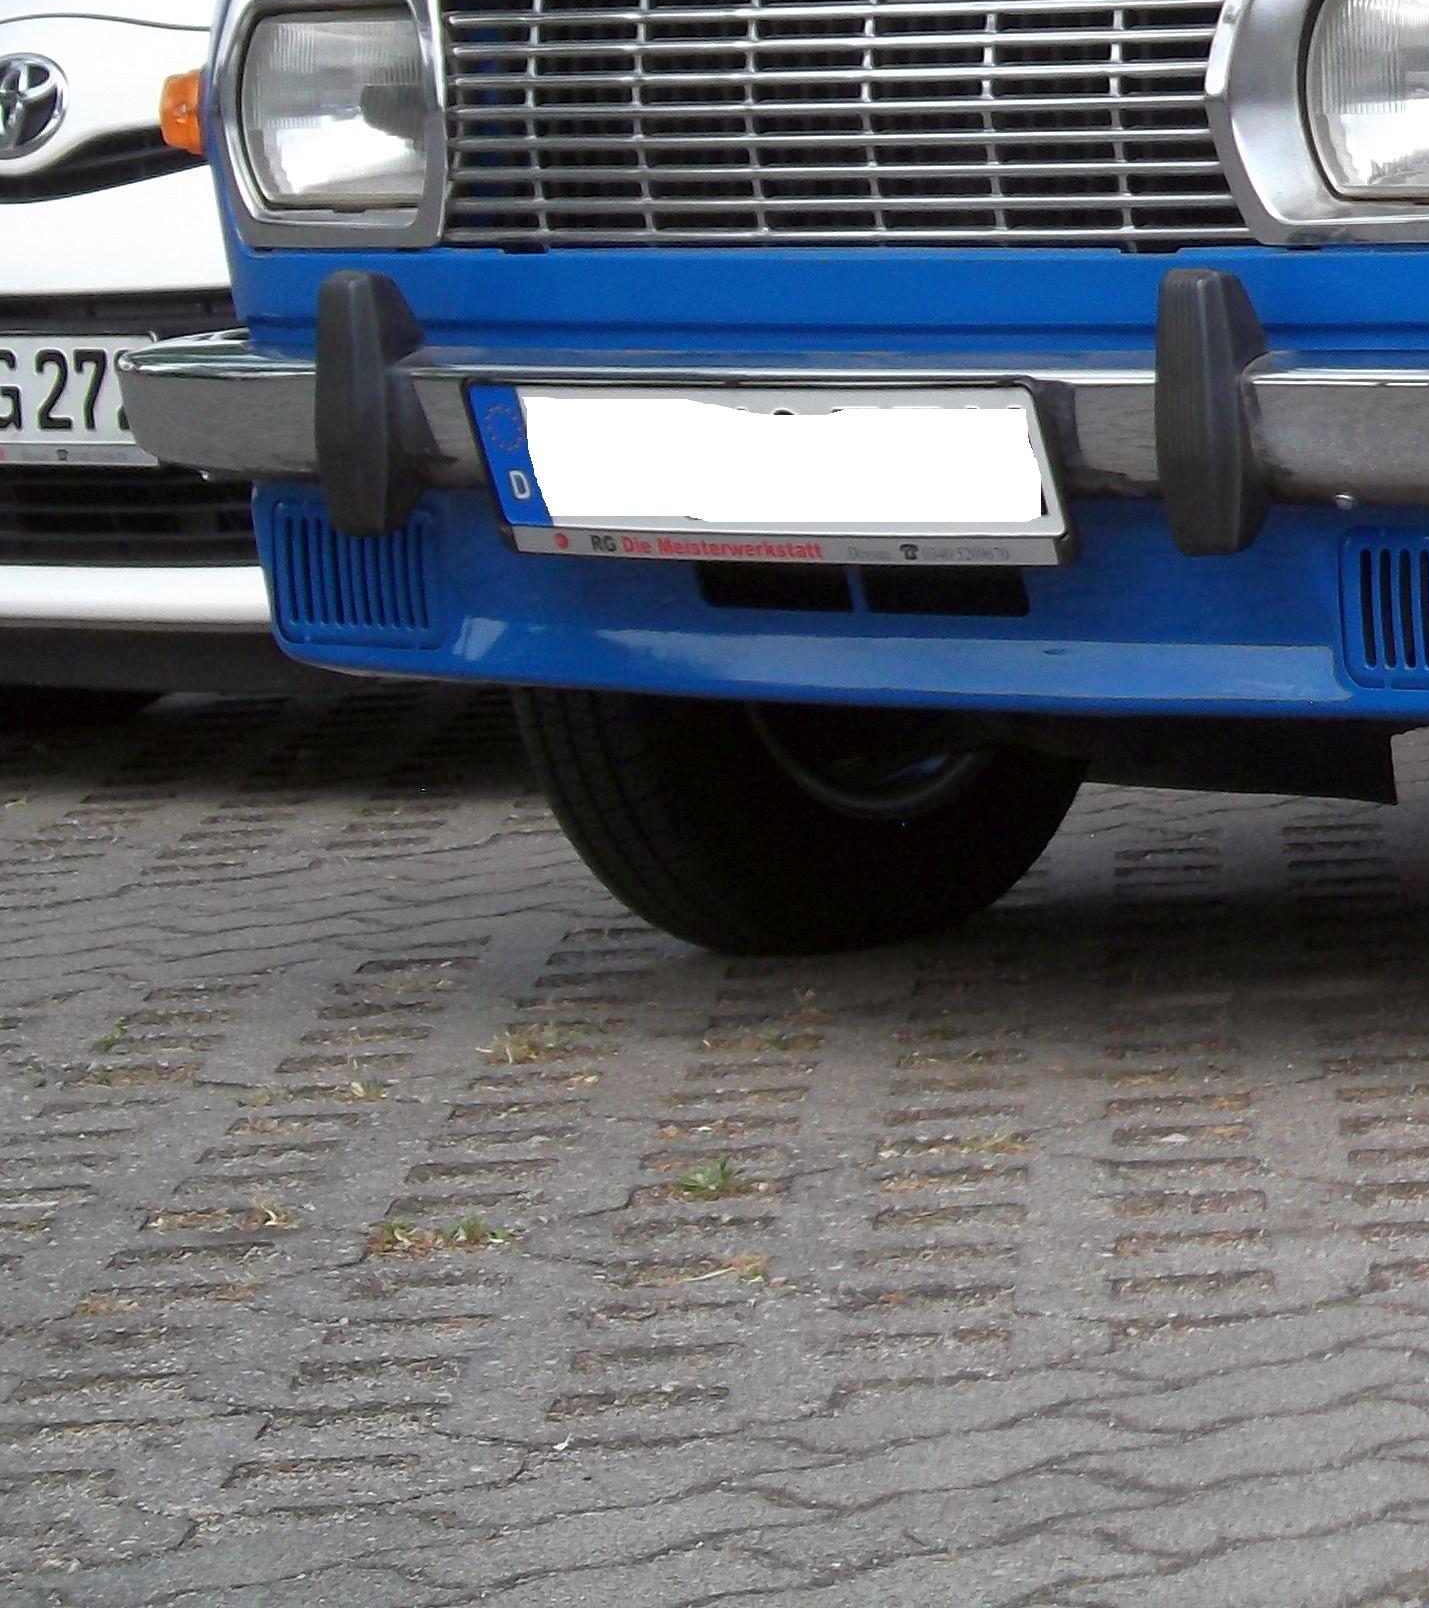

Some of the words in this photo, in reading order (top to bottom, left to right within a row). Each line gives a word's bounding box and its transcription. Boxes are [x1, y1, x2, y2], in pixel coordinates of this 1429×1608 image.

[509, 470, 530, 500] D
[590, 534, 617, 552] RG
[621, 536, 652, 554] Die
